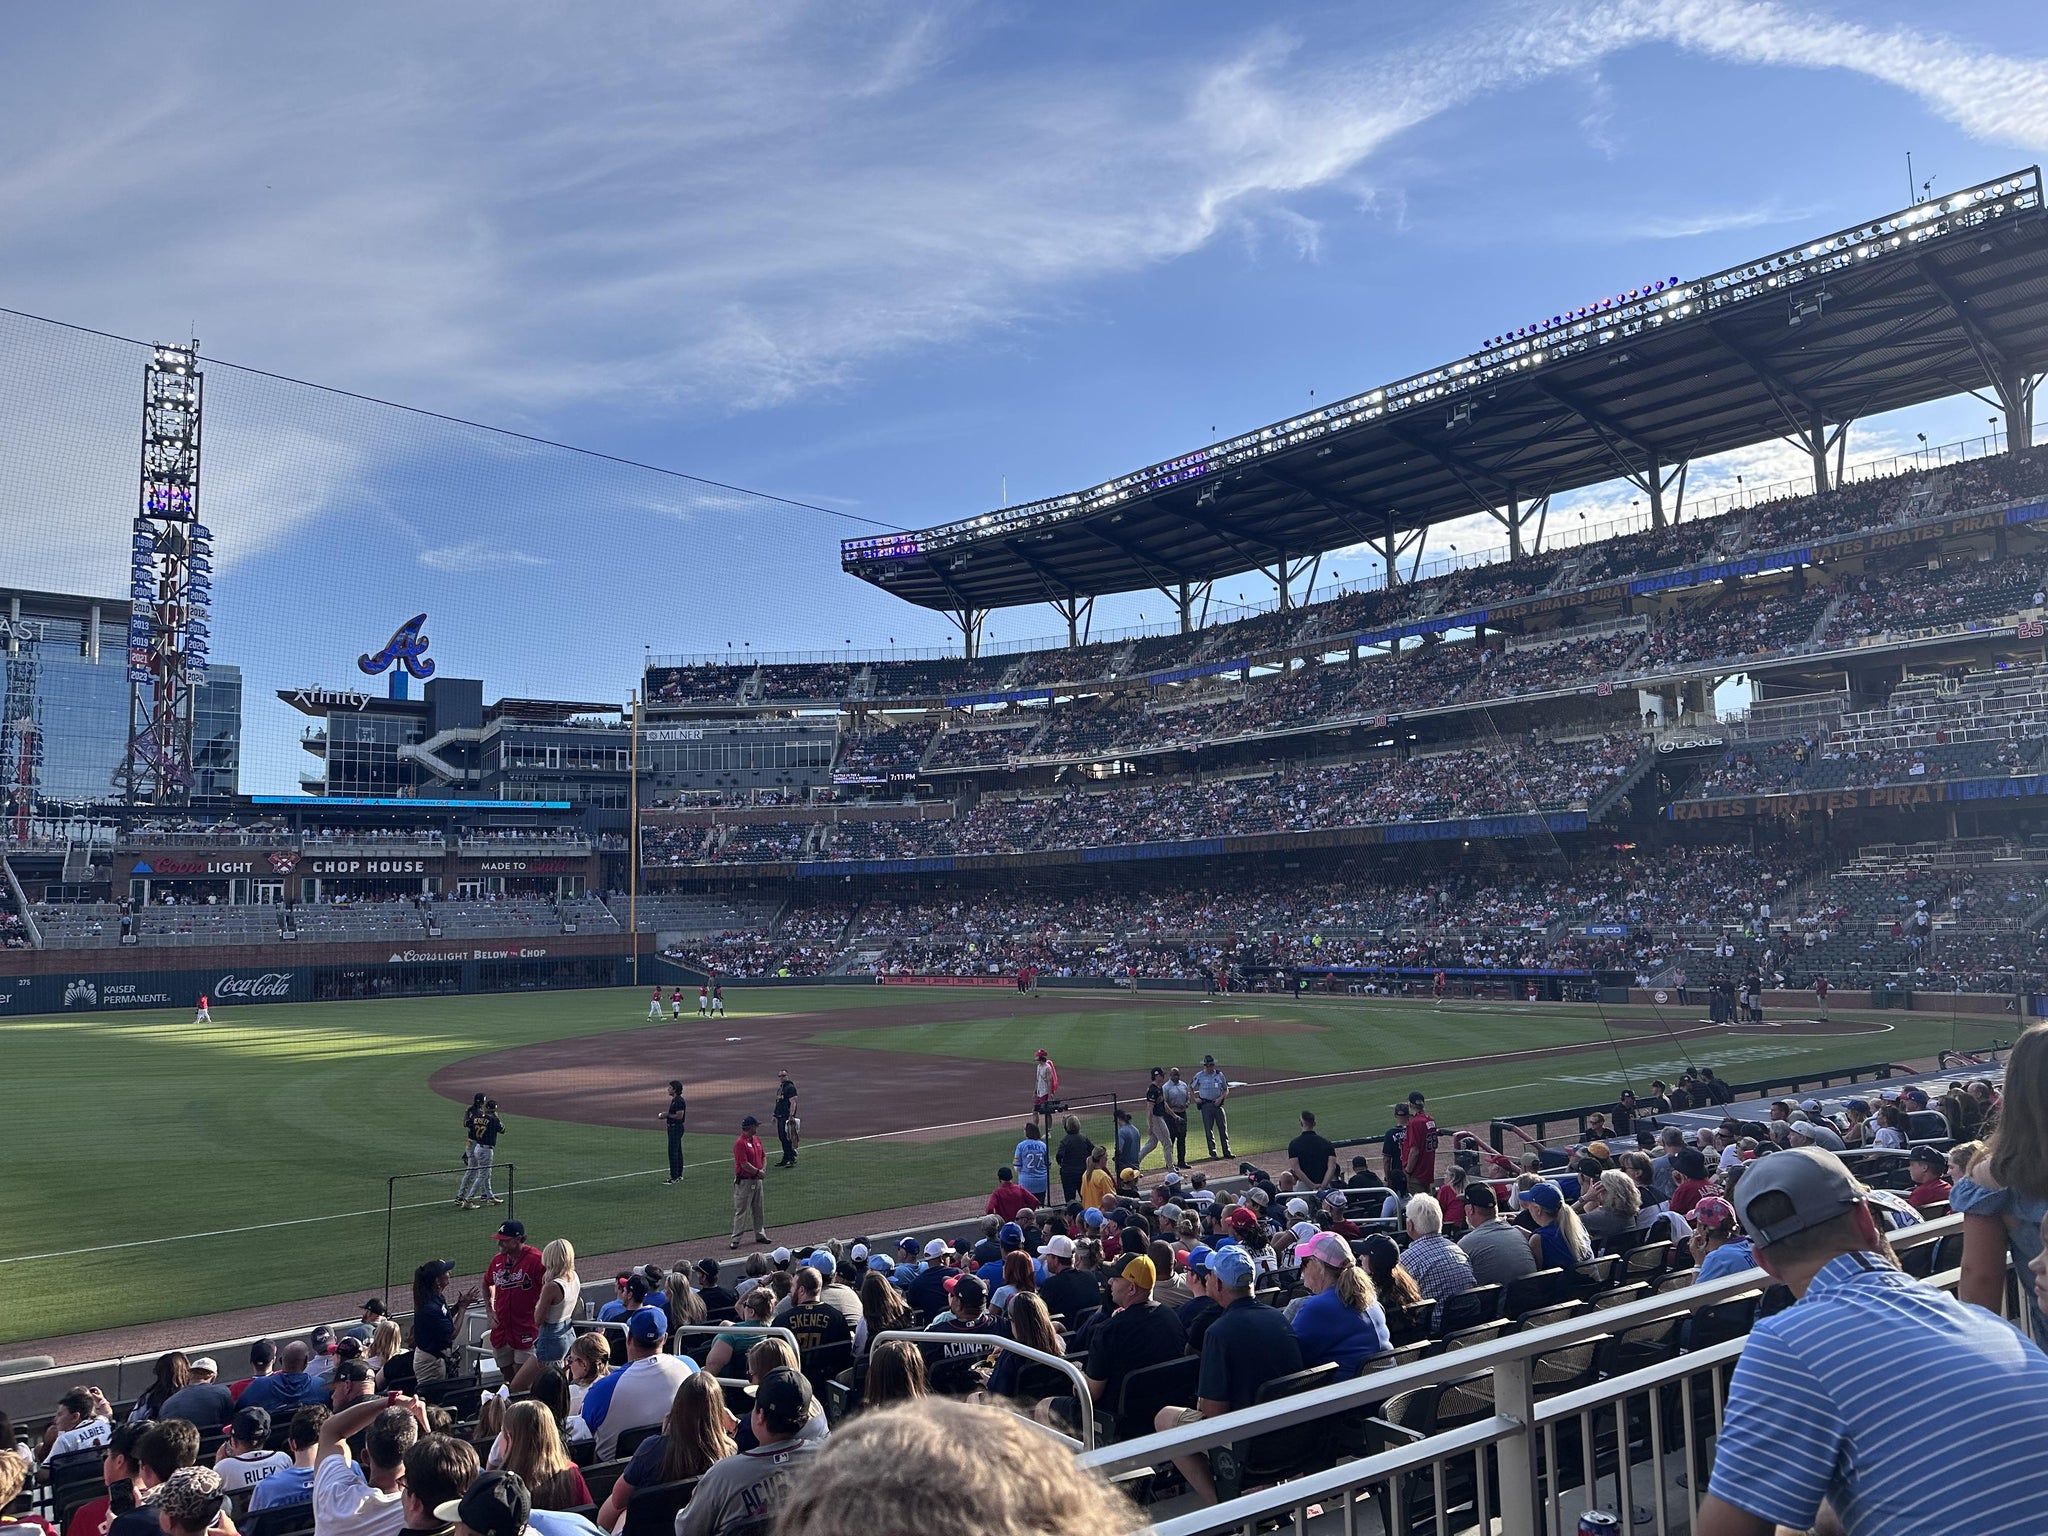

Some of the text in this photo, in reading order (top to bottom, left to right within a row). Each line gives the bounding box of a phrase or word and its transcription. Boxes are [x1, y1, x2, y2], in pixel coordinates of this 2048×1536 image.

[192, 526, 208, 538] 1997
[1811, 513, 2006, 561] RATES PIRATES PIRAT
[136, 554, 152, 564] 2000
[192, 559, 208, 570] 2001
[135, 570, 152, 580] 2002
[191, 575, 208, 586] 2003
[1636, 572, 1692, 593] BRAVES
[1700, 560, 1758, 581] BRAVES
[190, 592, 206, 602] 2005
[134, 602, 150, 612] 2010
[1488, 585, 1629, 622] RATES PIRATES PIRAT
[190, 608, 206, 618] 2012
[133, 619, 149, 630] 2013
[189, 624, 205, 634] 2018
[2018, 620, 2044, 639] 25
[1360, 630, 1400, 647] BRAVES
[1406, 619, 1450, 636] BRAVES
[132, 636, 148, 647] 2019
[188, 640, 204, 650] 2020
[132, 652, 148, 664] 2021
[1282, 643, 1322, 661] PIRATES
[188, 656, 204, 666] 2022
[131, 671, 148, 682] 2023
[188, 673, 204, 682] 2024
[1597, 682, 1612, 696] 21
[294, 683, 371, 711] xfinity
[877, 700, 917, 710] PIRATES
[1374, 714, 1386, 728] 10
[660, 730, 700, 740] MILNER
[1676, 738, 1723, 749] LEXUS
[1673, 784, 1944, 820] RATES PIRATES PIRAT
[1395, 822, 1462, 842] BRAVES
[1468, 815, 1542, 836] BRAVES
[1274, 832, 1334, 850] PIRATES
[1087, 848, 1130, 862] BRAVES
[154, 857, 253, 874] Coors LIGHT
[313, 861, 424, 873] CHOP HOUSE
[482, 862, 510, 870] MADE
[512, 862, 526, 870] TO
[695, 864, 751, 878] PIRATES
[864, 859, 914, 873] BRAVES
[404, 950, 437, 962] Coors
[438, 952, 468, 960] LIGHT
[104, 985, 136, 994] KAISER
[1026, 1153, 1042, 1168] 27
[789, 1313, 830, 1329] SKENES
[79, 1426, 105, 1442] ALBIES
[244, 1466, 276, 1484] RILEY
